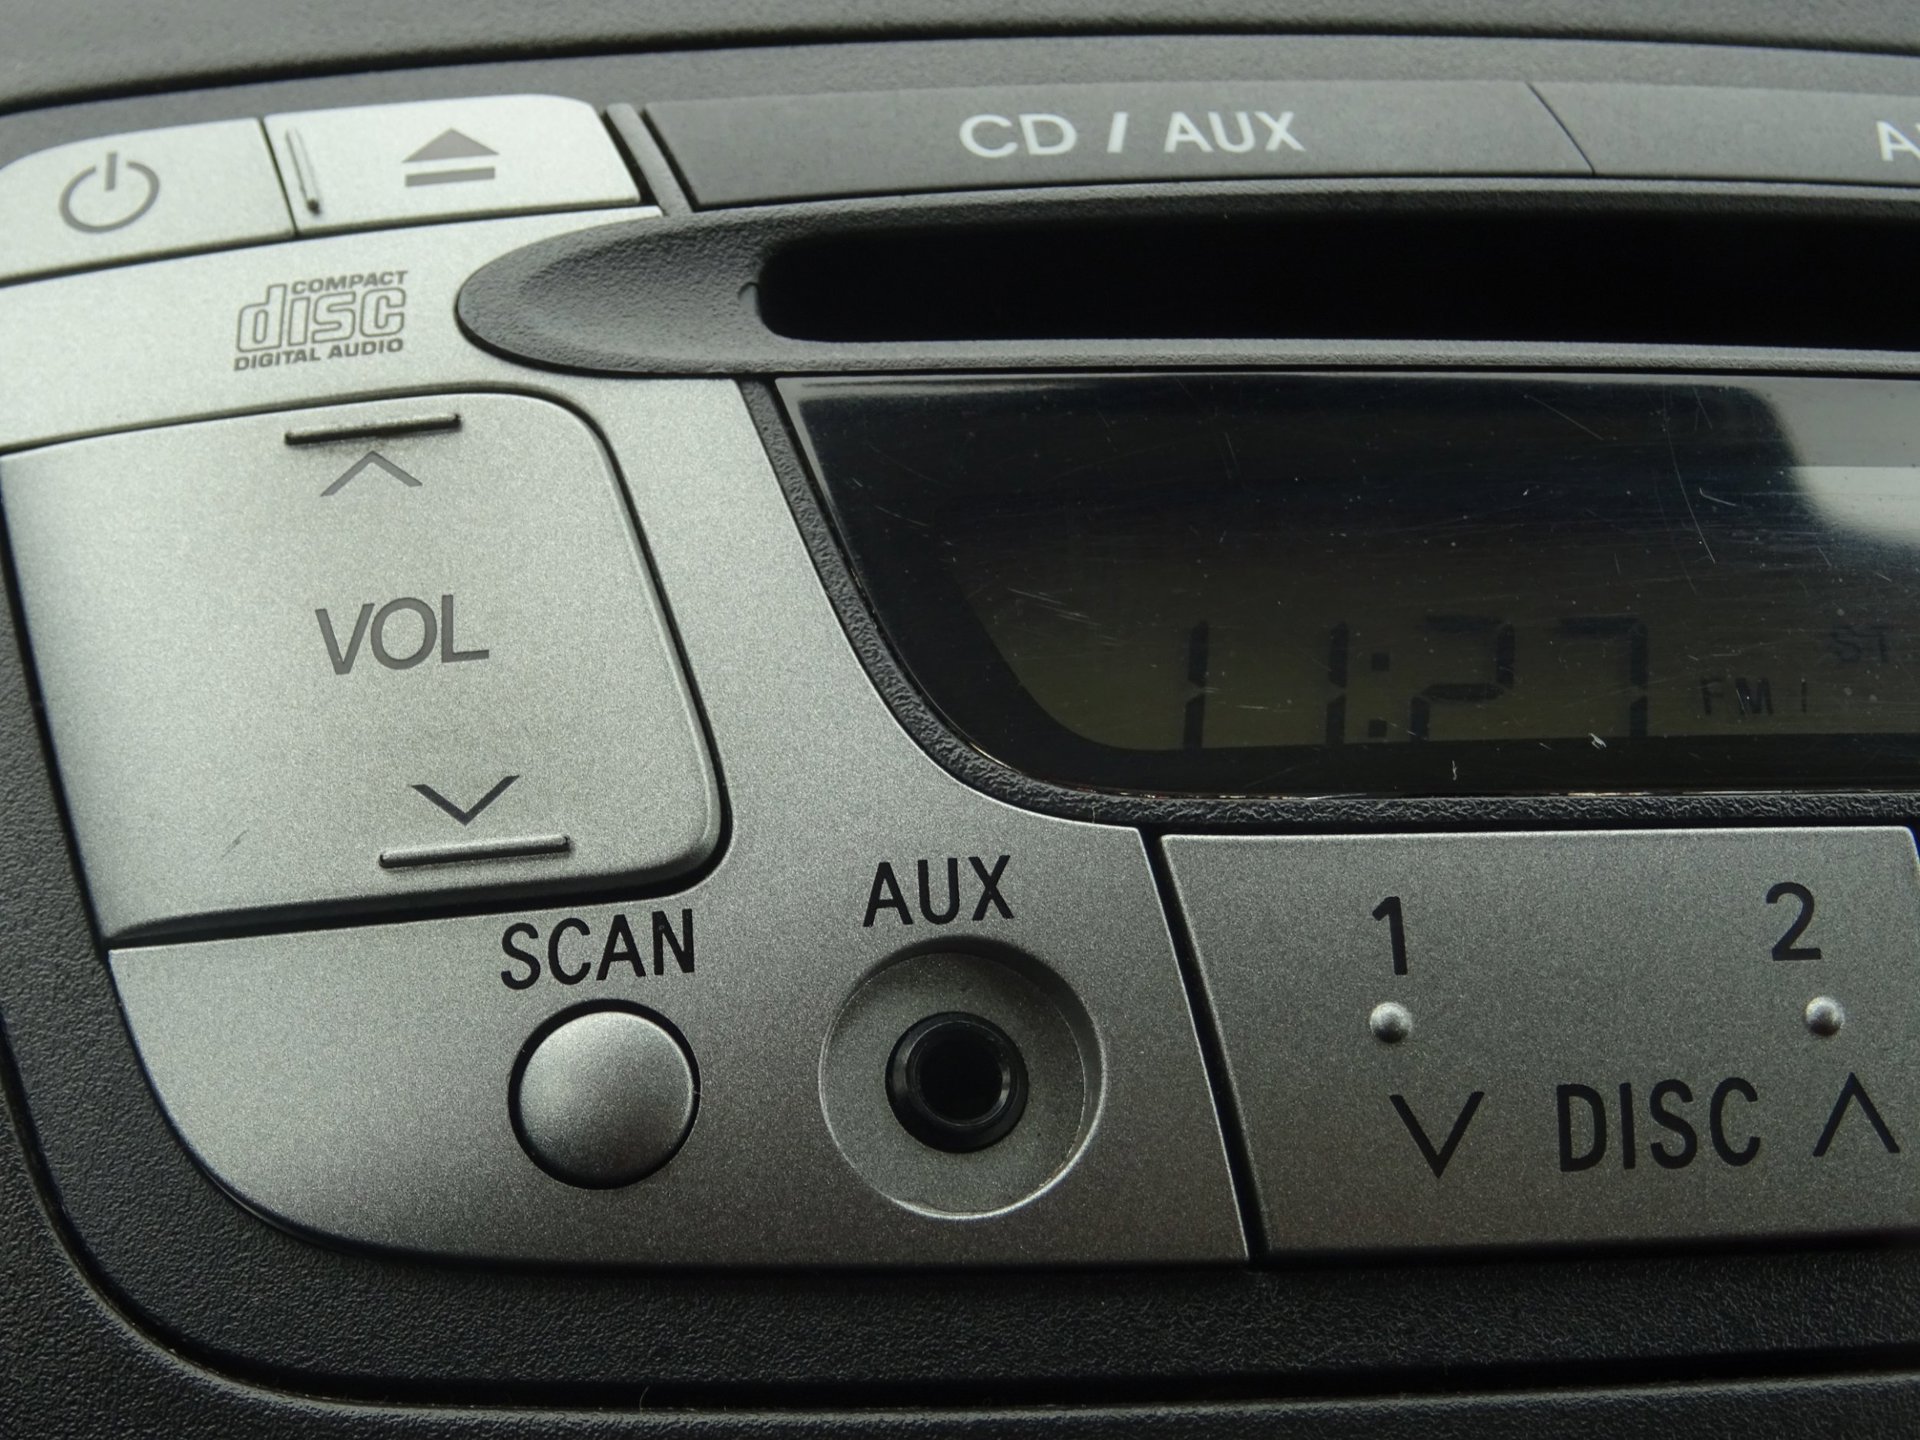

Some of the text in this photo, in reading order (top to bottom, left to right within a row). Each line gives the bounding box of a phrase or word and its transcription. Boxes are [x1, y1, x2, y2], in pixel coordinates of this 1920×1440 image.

[959, 113, 1077, 159] CD
[1164, 111, 1306, 153] AUX
[236, 283, 406, 353] disc
[291, 270, 408, 295] COMPACT
[233, 338, 404, 372] DIGITAL AUDIO
[315, 594, 489, 675] VOL
[1182, 613, 1650, 751] 11:27
[862, 855, 1015, 927] AUX
[1765, 881, 1822, 961] 2
[500, 908, 695, 990] SCAN
[1372, 896, 1408, 976] 1
[1555, 1077, 1760, 1172] DISC
